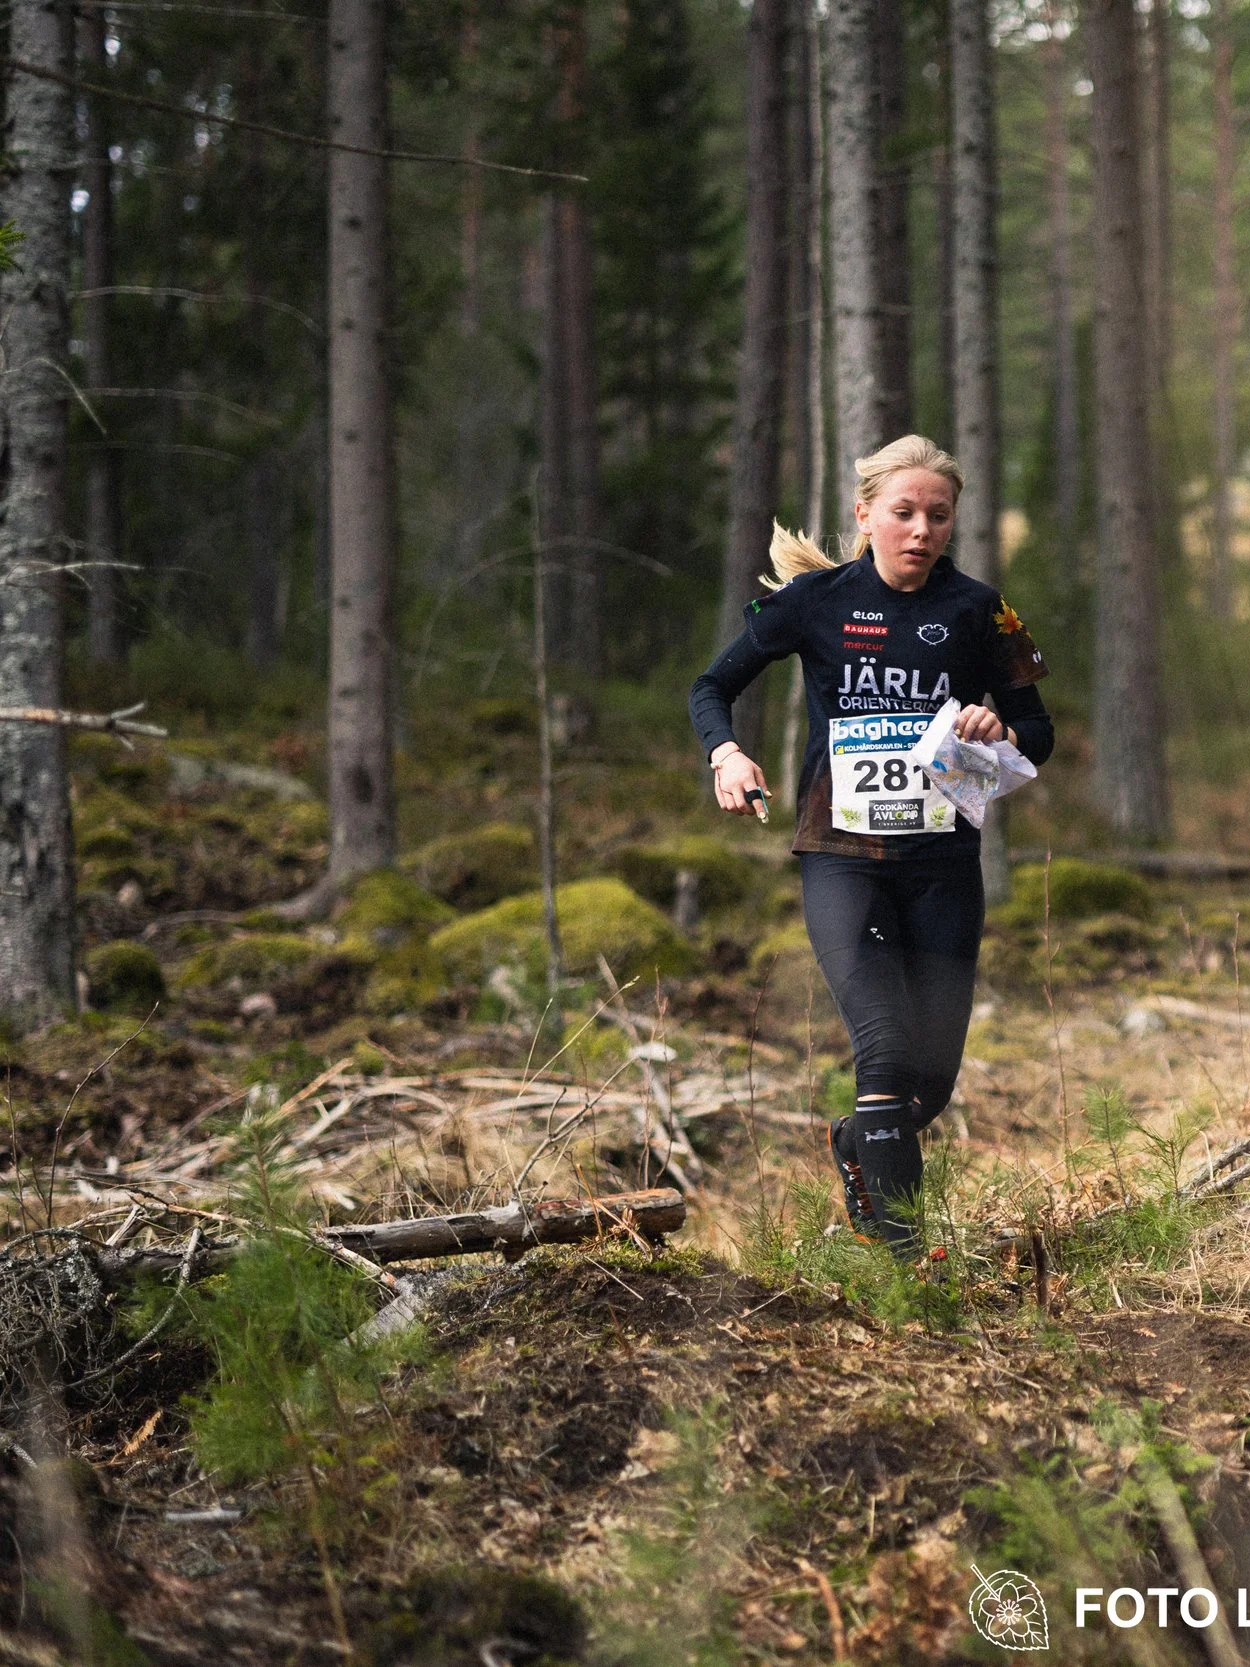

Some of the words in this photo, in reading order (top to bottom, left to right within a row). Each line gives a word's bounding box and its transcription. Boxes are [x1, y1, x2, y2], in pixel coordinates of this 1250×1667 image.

[844, 626, 888, 635] BAUHAUS
[838, 656, 950, 701] JÄRLA
[839, 696, 941, 712] ORIENTERIN
[853, 758, 931, 793] 281
[873, 802, 919, 811] GODKÄNDA
